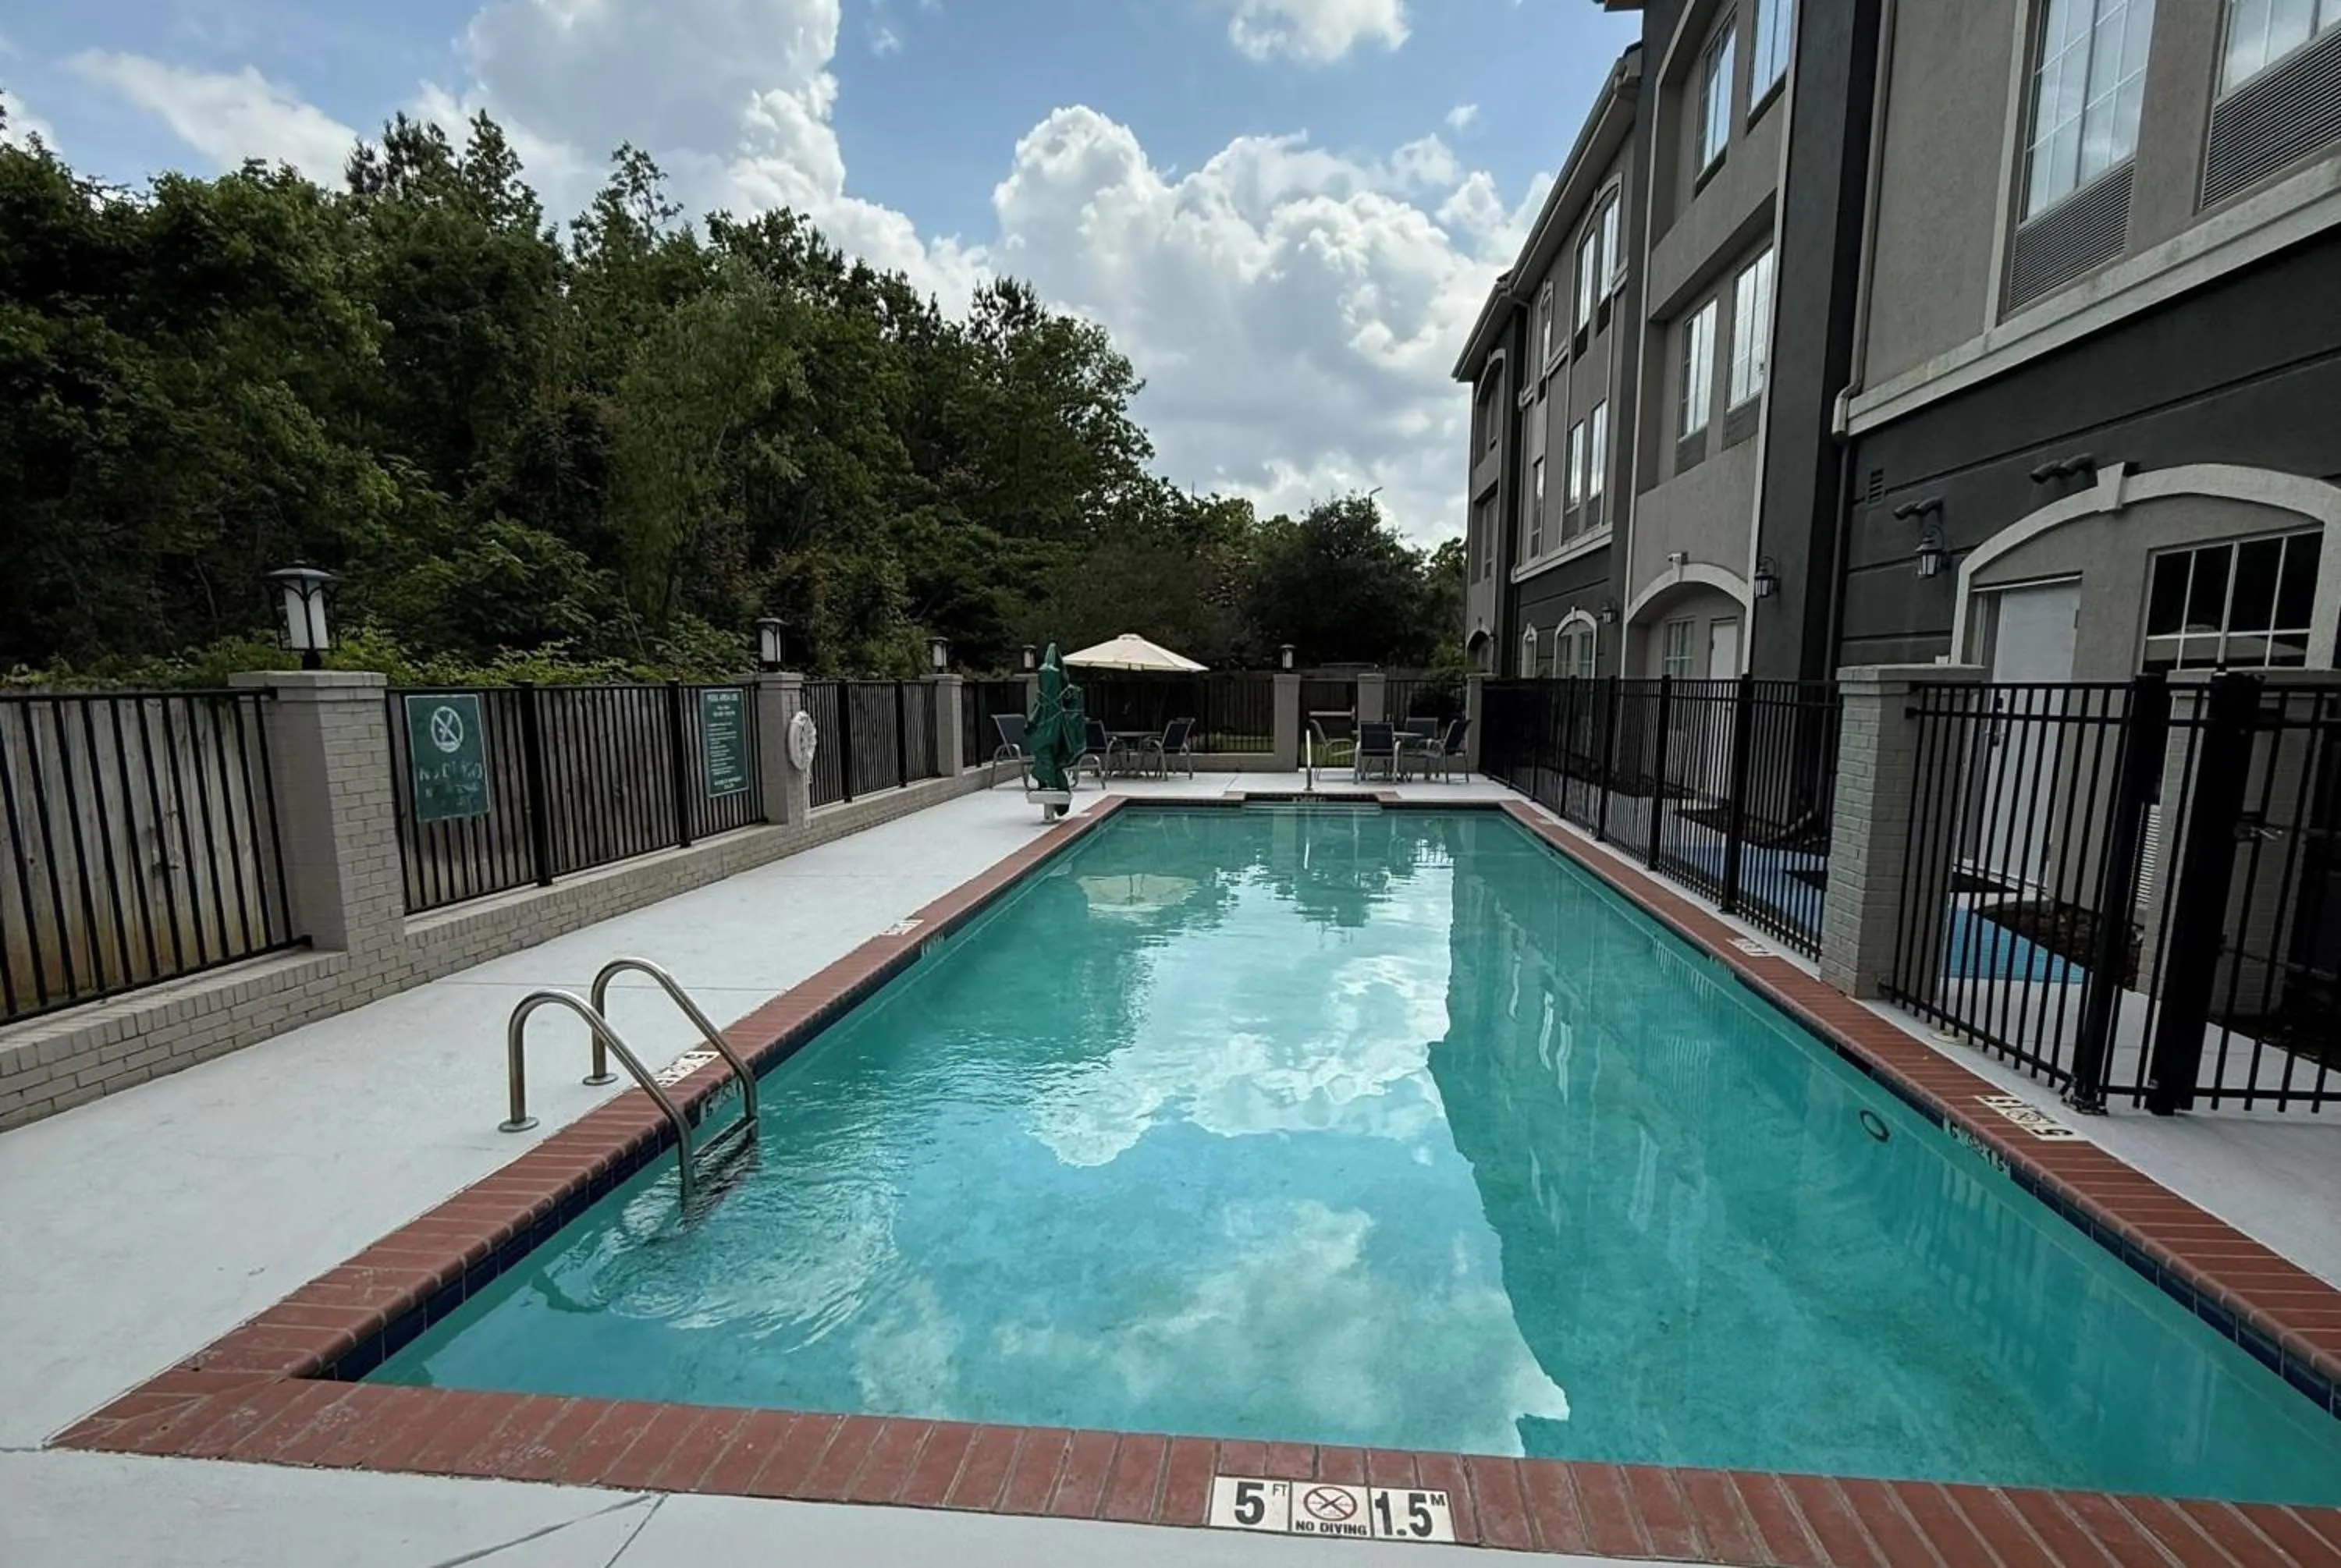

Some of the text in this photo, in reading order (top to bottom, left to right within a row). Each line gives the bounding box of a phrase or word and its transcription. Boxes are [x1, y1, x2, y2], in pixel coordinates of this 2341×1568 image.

[1234, 1481, 1288, 1525] 5 FT
[1375, 1491, 1446, 1537] 1.5 M
[1295, 1521, 1367, 1536] NO DIVING
